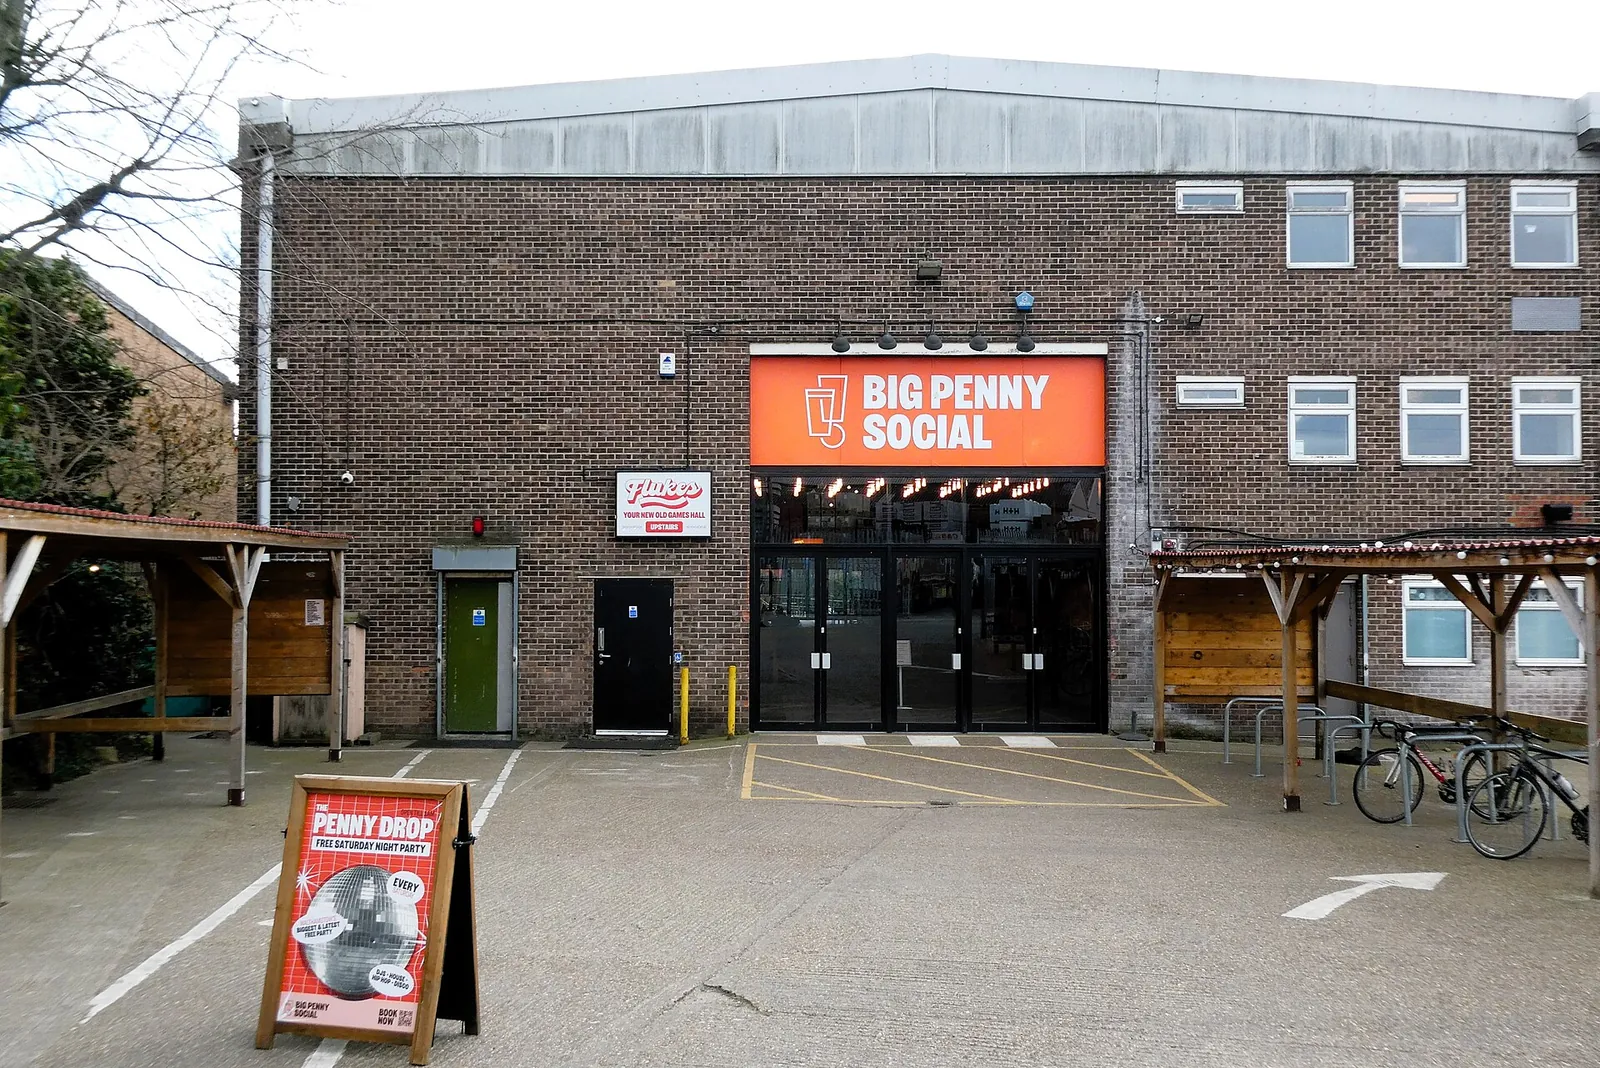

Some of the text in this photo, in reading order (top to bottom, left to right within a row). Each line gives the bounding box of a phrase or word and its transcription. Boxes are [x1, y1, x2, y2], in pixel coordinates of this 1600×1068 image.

[863, 374, 1050, 410] BIG PENNY
[862, 413, 993, 450] SOCIAL
[625, 478, 703, 505] Flukes
[623, 511, 705, 519] YOUR NEW OLD GAMES HALL
[650, 523, 679, 531] UPSTAIRS
[315, 803, 329, 811] THE
[312, 812, 434, 840] PENNY DROP
[315, 838, 426, 853] FREE SATURDAY NIGHT PARTY
[392, 877, 420, 893] EVERY
[296, 924, 317, 934] BIGGEST
[322, 921, 340, 930] LATEST
[316, 928, 333, 937] PARTY
[393, 980, 410, 990] DISCO
[295, 1000, 330, 1011] BIG PENNY
[294, 1009, 318, 1019] SOCIAL
[378, 1008, 398, 1017] BOOK
[377, 1016, 395, 1026] NOW
